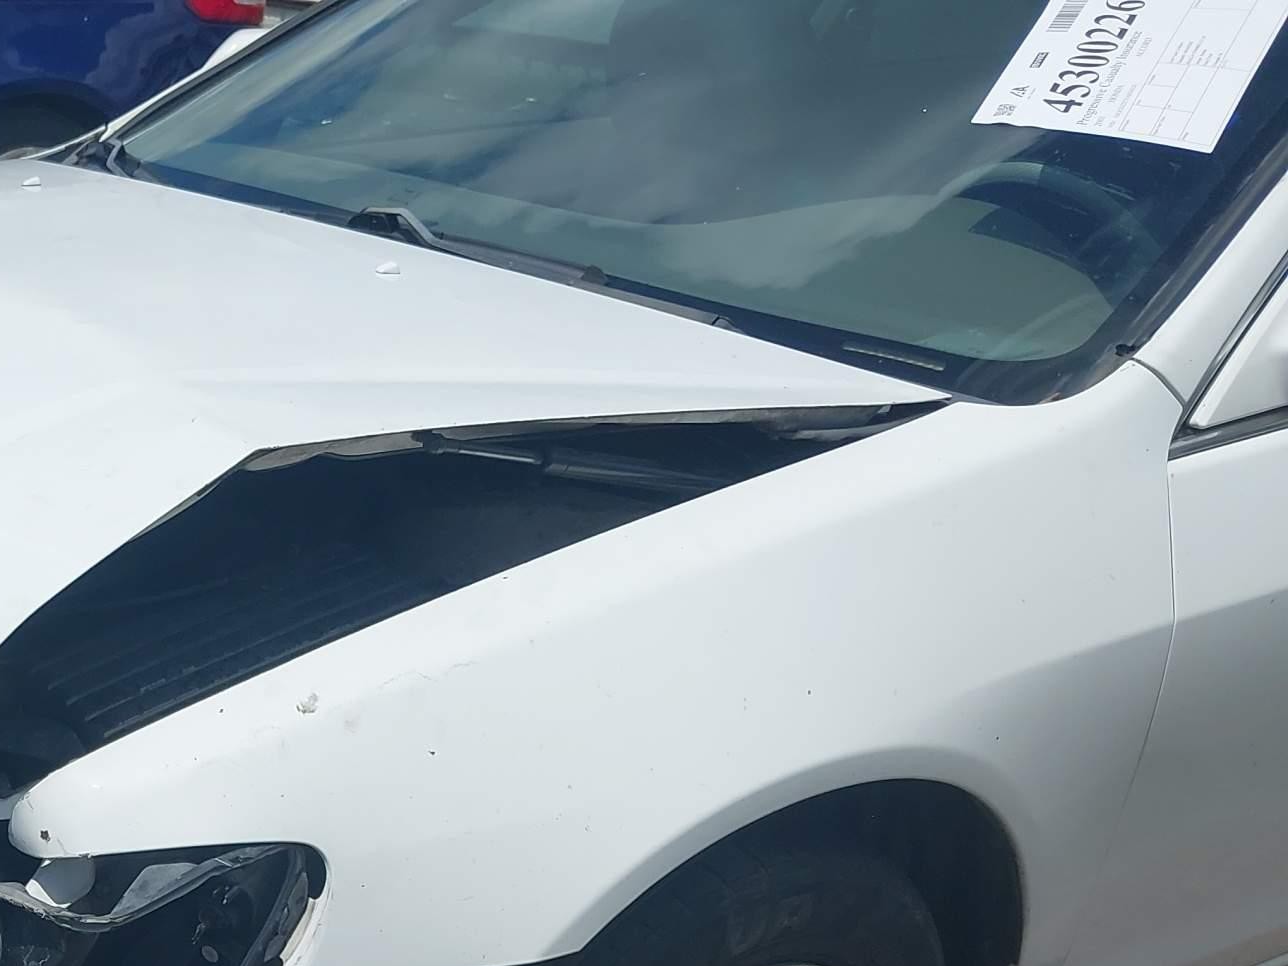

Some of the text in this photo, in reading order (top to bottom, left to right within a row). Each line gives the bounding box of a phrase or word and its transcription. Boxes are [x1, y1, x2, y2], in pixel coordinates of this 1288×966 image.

[1042, 0, 1145, 114] 45300226
[1076, 82, 1107, 126] Progressive
[1099, 59, 1128, 88] Casualty
[1119, 31, 1143, 64] Insurance
